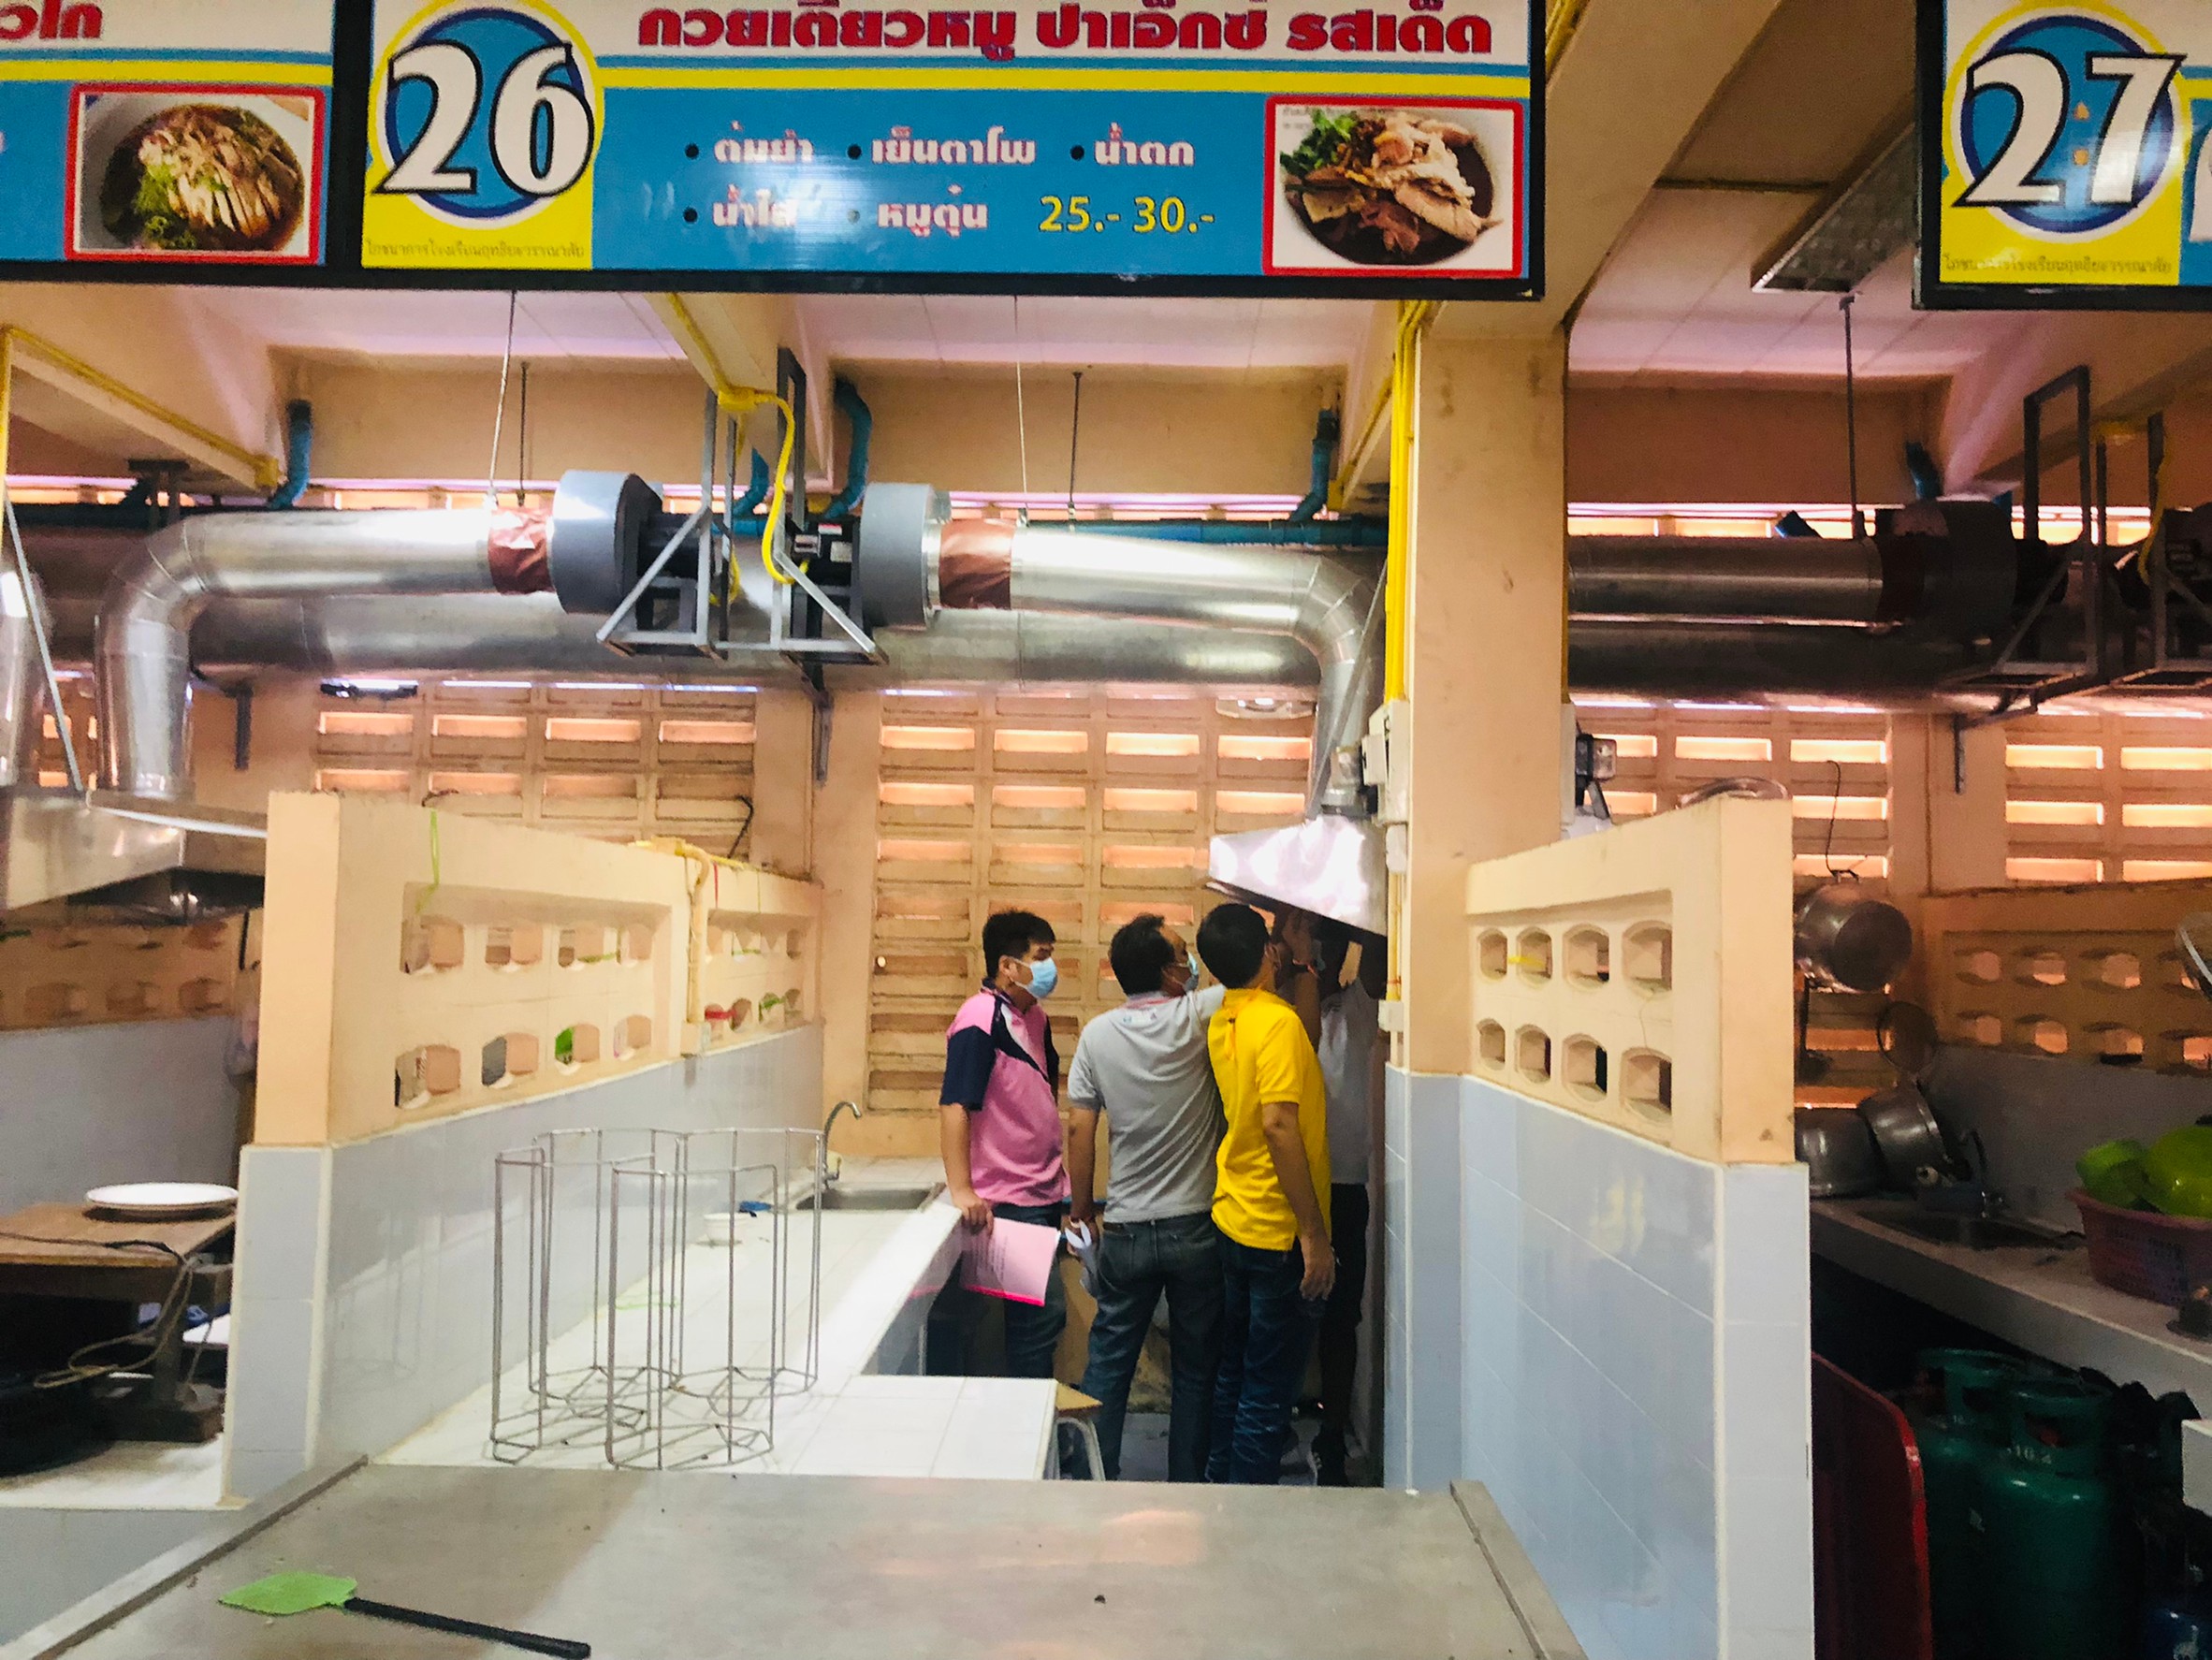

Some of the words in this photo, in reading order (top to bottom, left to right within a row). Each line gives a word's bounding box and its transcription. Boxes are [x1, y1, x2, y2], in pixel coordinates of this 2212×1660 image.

[371, 38, 596, 197] 26
[1951, 47, 2188, 208] 27
[1039, 195, 1121, 233] 25.-
[1133, 196, 1215, 234] 30.-
